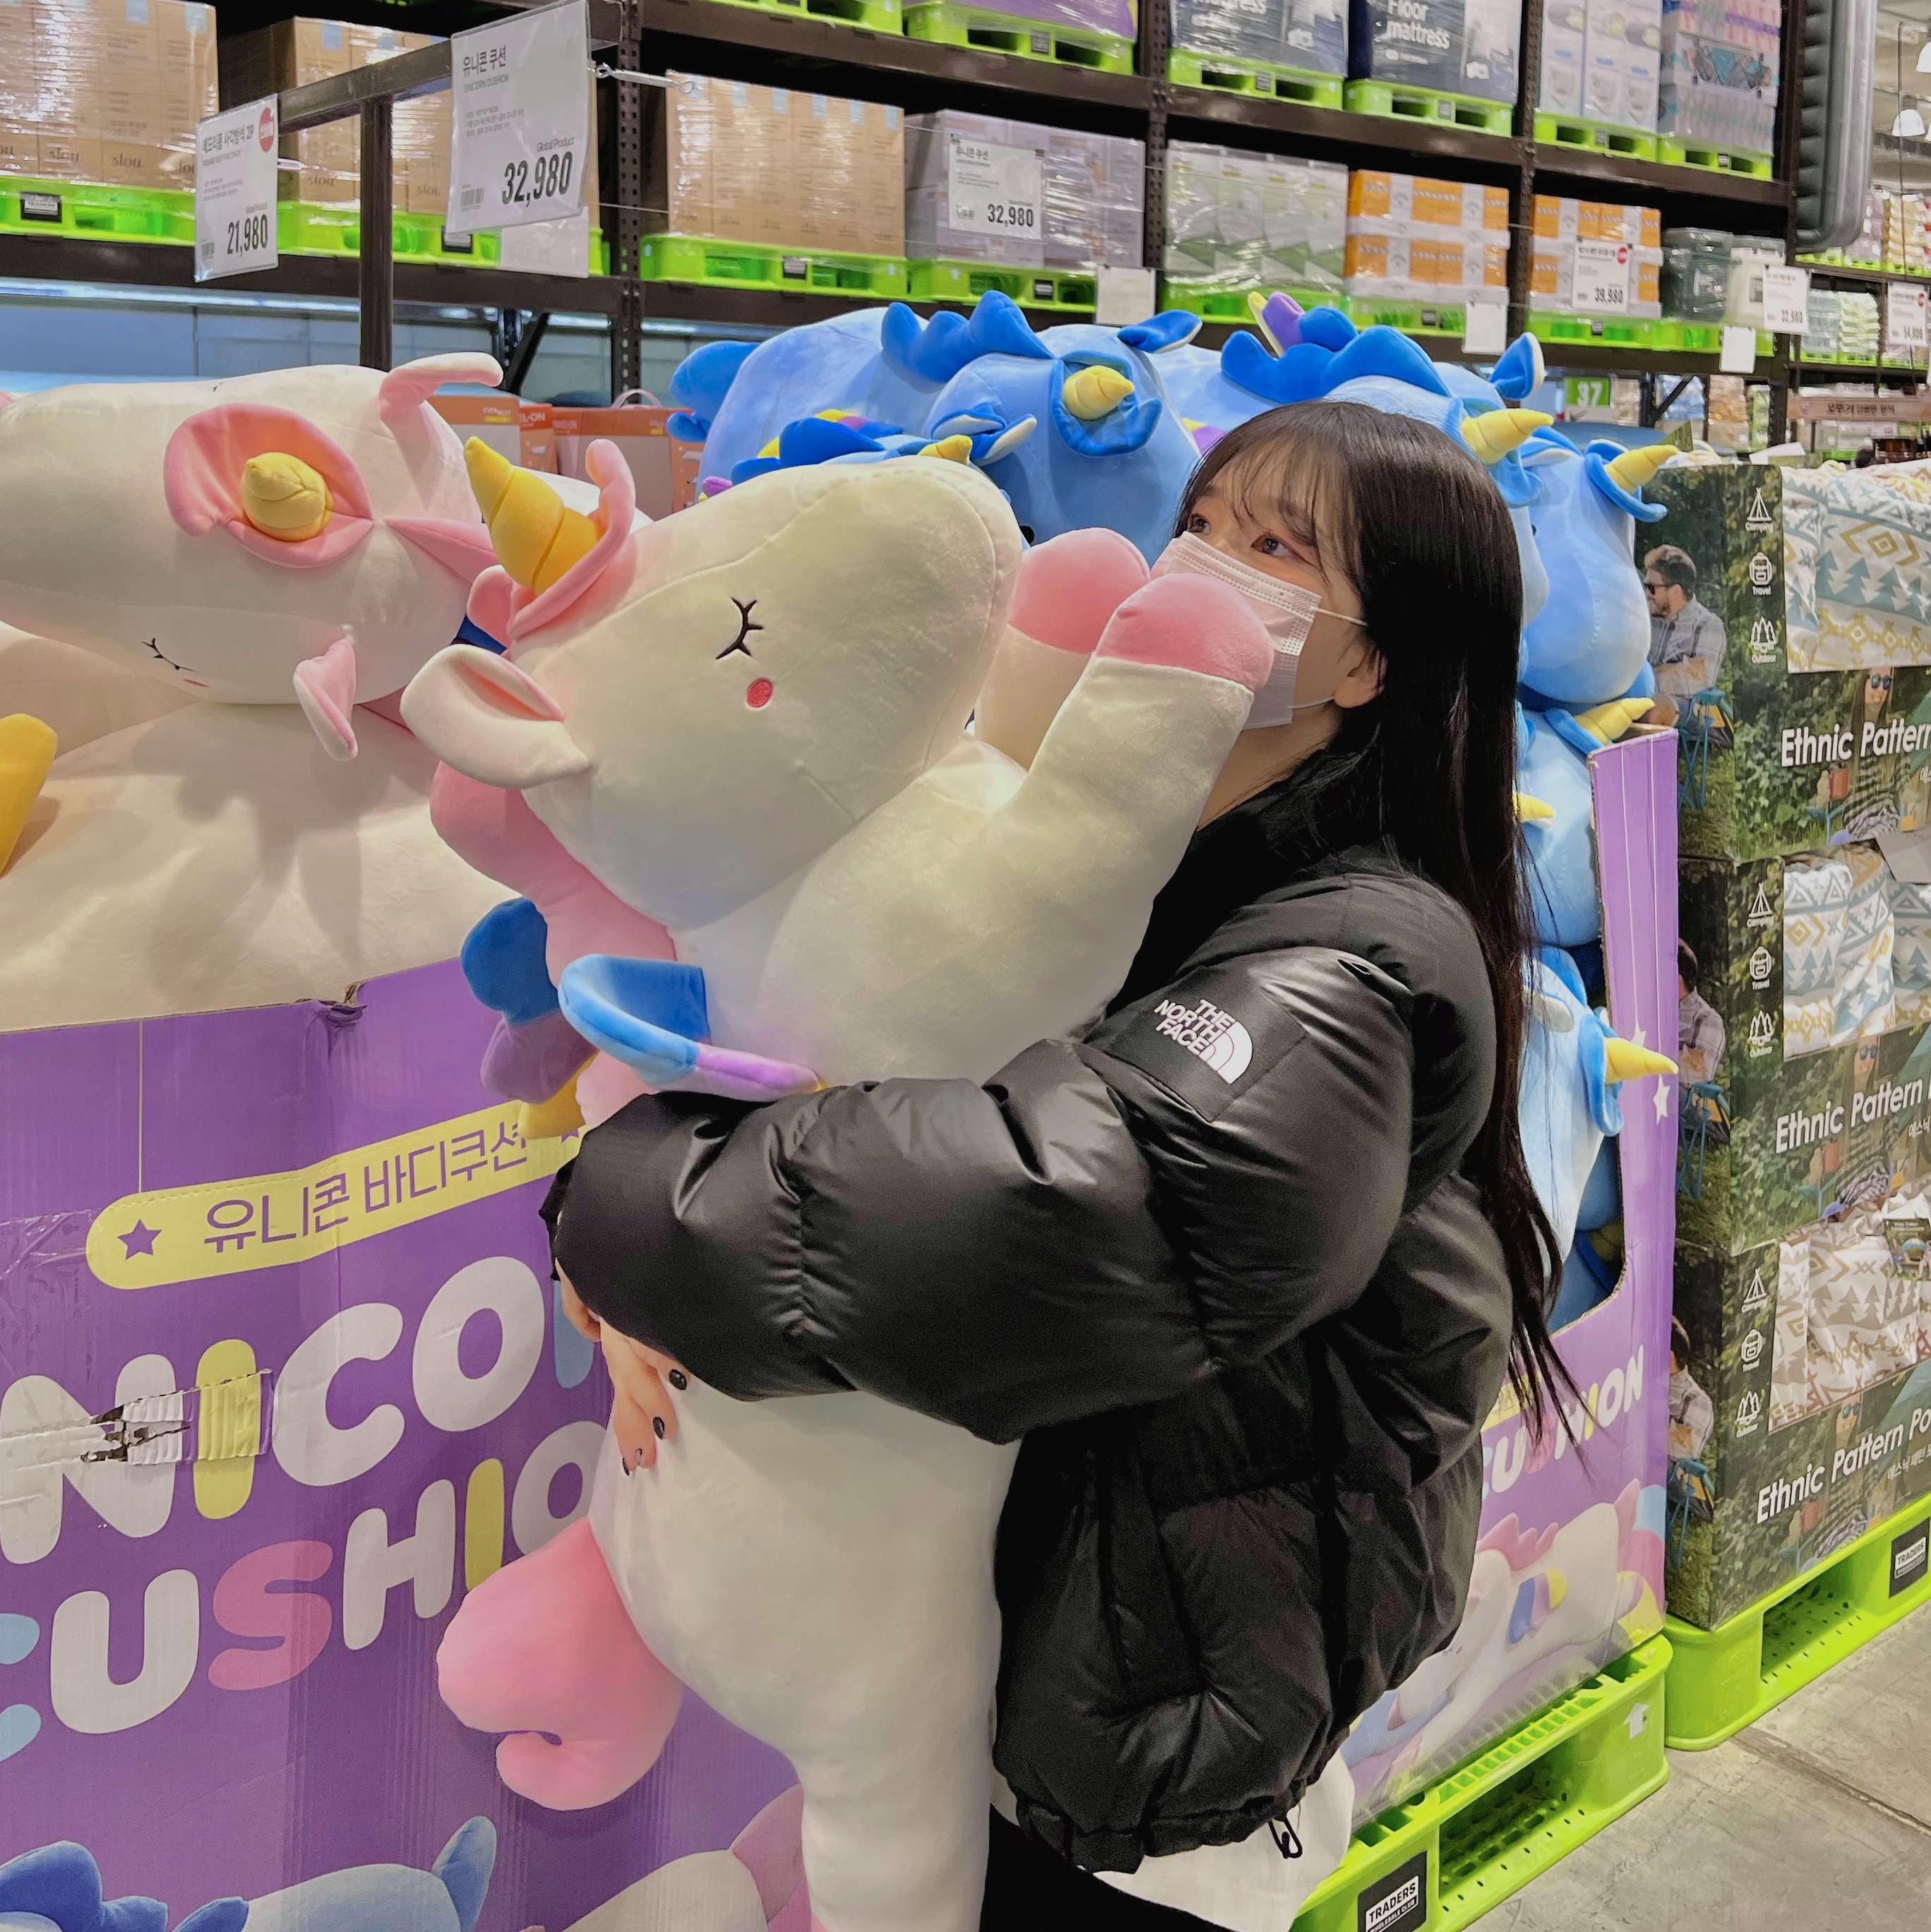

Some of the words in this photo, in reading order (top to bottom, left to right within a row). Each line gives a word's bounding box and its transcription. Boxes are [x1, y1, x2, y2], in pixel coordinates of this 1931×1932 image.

[1387, 20, 1450, 49] mattress
[463, 51, 487, 78] 유니콘
[489, 44, 506, 70] 쿠션
[554, 137, 575, 148] Product
[502, 151, 573, 208] 32,980
[988, 203, 1034, 227] 32,980
[227, 214, 268, 258] 21,980
[1745, 522, 1774, 533] Camping
[1752, 586, 1771, 596] Travel
[1752, 654, 1776, 664] Outdoor
[1781, 723, 1854, 767] Ethnic
[1860, 718, 1931, 758] Pattern
[1752, 978, 1770, 990] Travel
[1154, 999, 1224, 1043] NORTH
[1195, 999, 1236, 1031] THE
[1155, 1018, 1211, 1055] FACE
[1776, 1100, 1845, 1154] Ethnic
[1851, 1079, 1923, 1128] Pattern
[205, 1172, 350, 1254] 유니콘
[364, 1122, 527, 1213] 바디쿠션
[1757, 1463, 1827, 1525] Ethnic
[1831, 1423, 1904, 1484] Pattern
[1369, 1882, 1416, 1923] TRADERS
